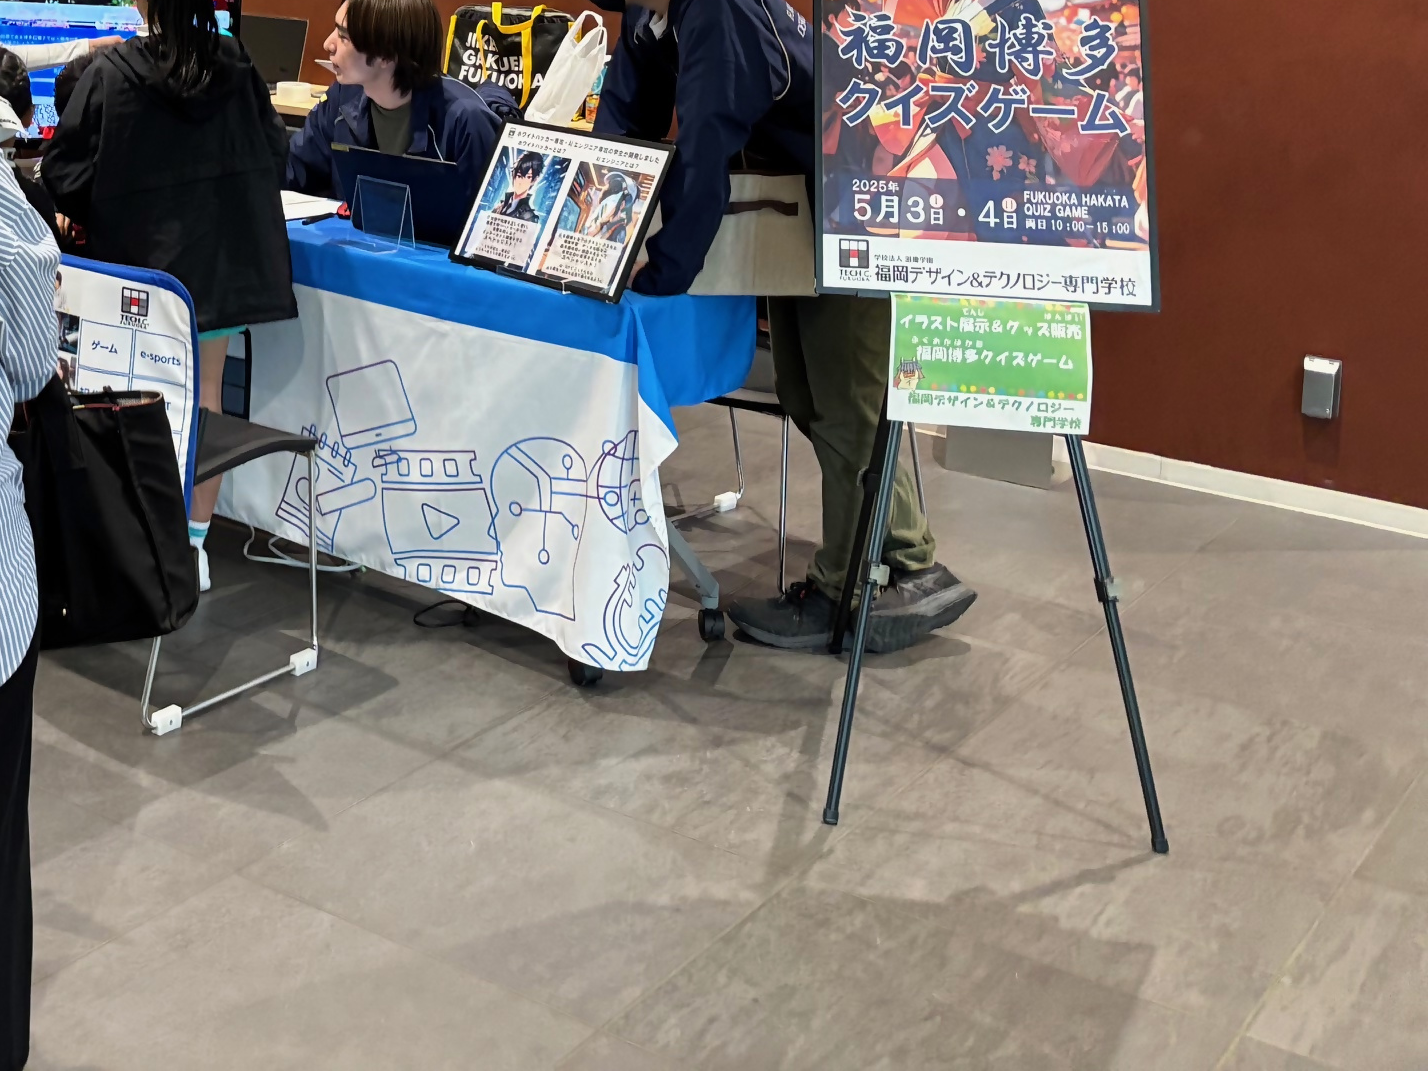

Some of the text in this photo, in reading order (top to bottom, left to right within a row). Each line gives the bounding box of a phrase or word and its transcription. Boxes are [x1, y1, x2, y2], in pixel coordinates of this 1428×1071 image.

[837, 4, 1119, 80] 福岡博多
[836, 78, 1131, 137] クイズゲーム
[852, 179, 899, 193] 2025年
[1023, 190, 1078, 205] FUKUOKA
[1081, 193, 1129, 208] HAKATA
[1024, 203, 1052, 216] QUIZ
[1055, 205, 1089, 219] GAME
[875, 263, 1137, 297] 福岡デザイン&テクノロジー専門学校
[899, 314, 1082, 340] イラスト展示&グッズ販売
[91, 340, 118, 355] ゲーム
[140, 349, 181, 366] e-sports
[916, 345, 1074, 370] 福岡博多クイズゲーム
[908, 392, 1075, 414] 福岡デザイン&テクノロジー
[1030, 415, 1082, 430] 専門学校
